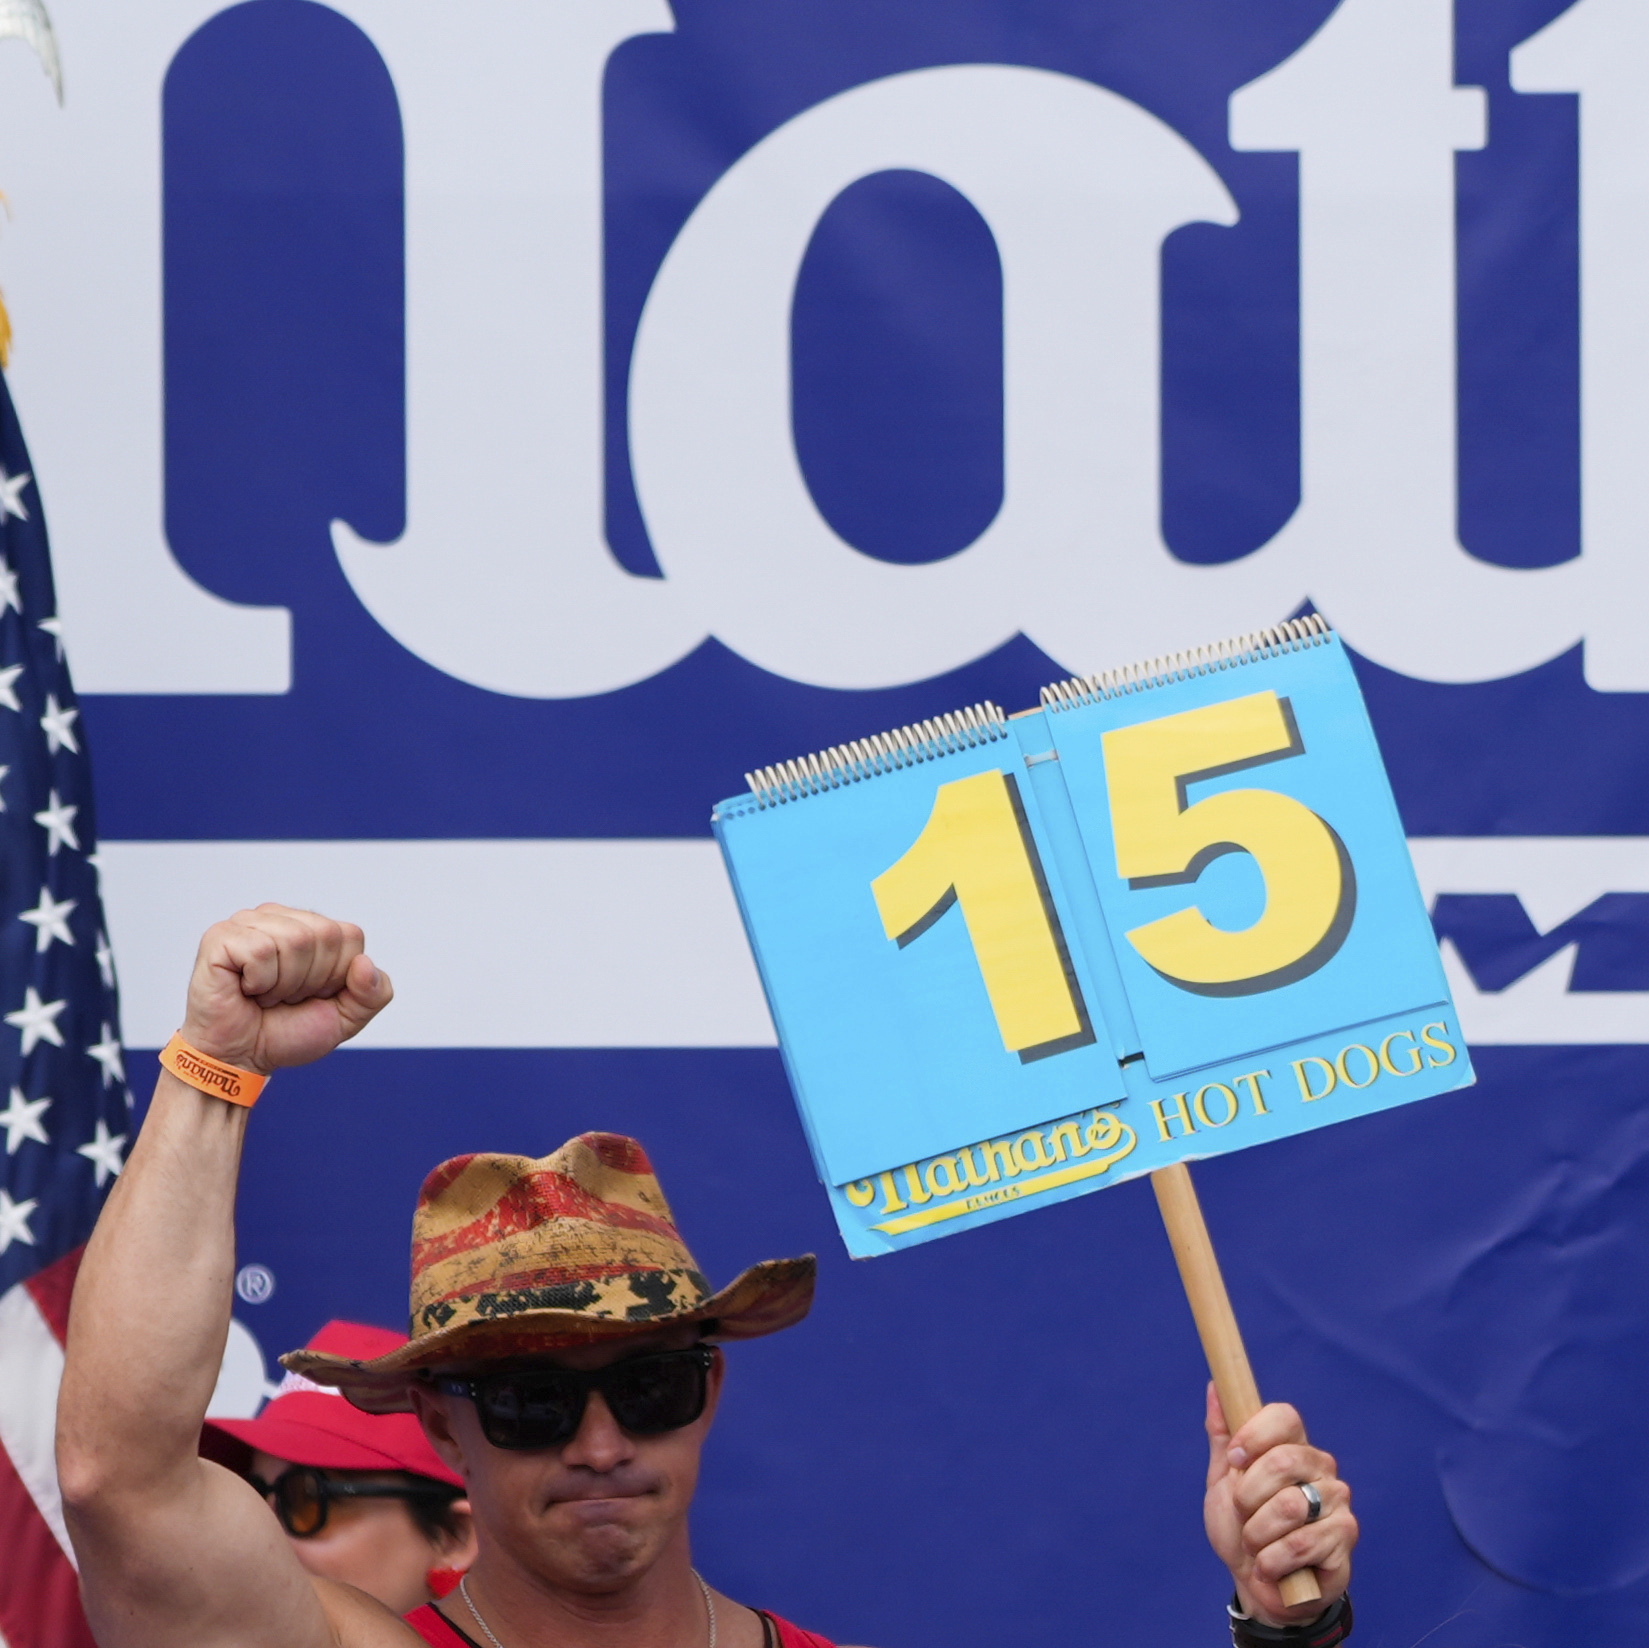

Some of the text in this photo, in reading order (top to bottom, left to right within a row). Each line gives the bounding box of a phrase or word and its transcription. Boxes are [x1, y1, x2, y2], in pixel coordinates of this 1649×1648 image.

[870, 690, 1352, 1060] 15
[1147, 1069, 1272, 1143] HOT
[1291, 1021, 1458, 1103] DOGS
